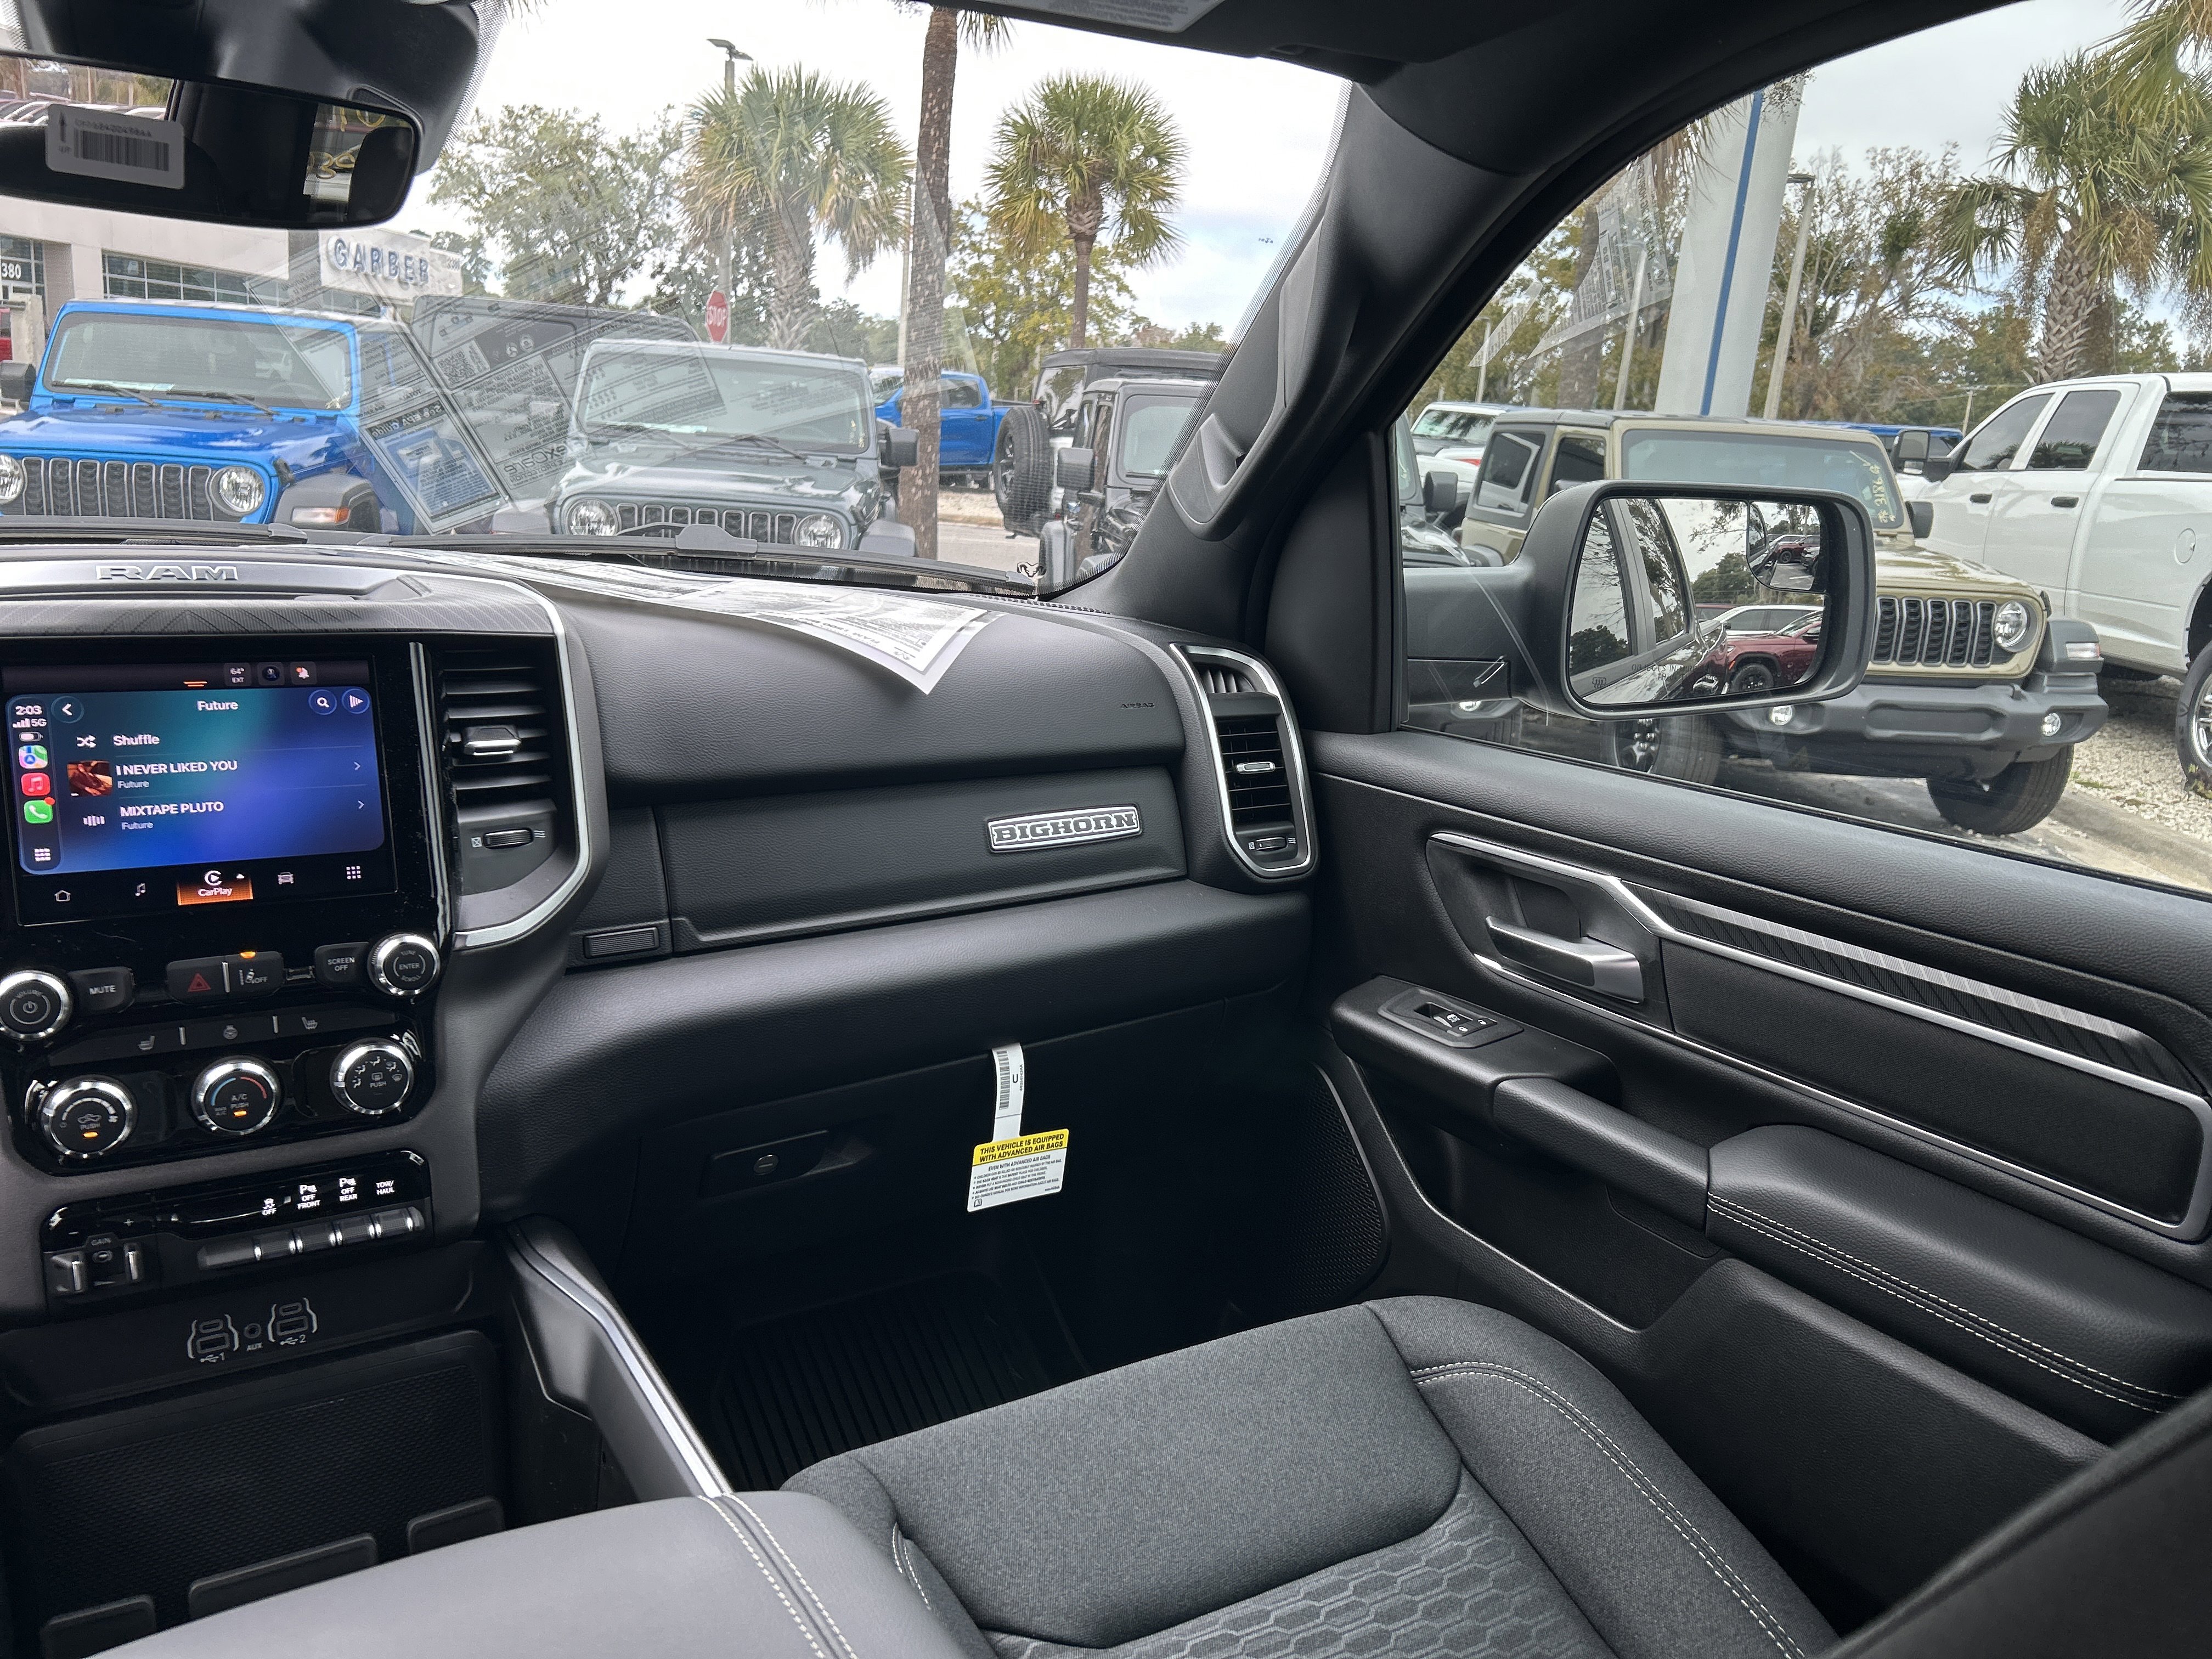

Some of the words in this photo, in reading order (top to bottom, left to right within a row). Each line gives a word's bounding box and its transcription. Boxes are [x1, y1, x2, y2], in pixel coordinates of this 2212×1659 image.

[332, 237, 430, 284] GARBER
[707, 306, 729, 328] STOP
[95, 565, 238, 581] RAM
[15, 705, 42, 715] 2:03
[196, 700, 239, 711] Future
[31, 718, 47, 727] 5G
[113, 734, 160, 746] Shuffle
[116, 765, 121, 776] I
[123, 763, 168, 775] NEVER
[170, 761, 207, 773] LIKED
[210, 760, 238, 771] YOU
[117, 780, 150, 789] Future
[120, 804, 178, 817] MIXTAPE
[180, 801, 224, 814] PLUTO
[121, 821, 154, 830] Future
[994, 812, 1136, 844] BIGHORN
[198, 887, 233, 896] CarPlay
[328, 957, 355, 966] SCREEN
[89, 985, 116, 995] MUTE
[1012, 1073, 1019, 1084] U
[980, 1146, 995, 1155] THIS
[997, 1141, 1024, 1152] VEHICLE
[1032, 1133, 1064, 1144] EQUIPPED
[979, 1153, 996, 1163] WITH
[997, 1147, 1033, 1159] ADVANCED
[1011, 1158, 1032, 1166] ADVANCED
[376, 1180, 394, 1189] TOW/
[339, 1194, 358, 1203] REAR
[297, 1200, 321, 1210] FRONT
[299, 1334, 306, 1343] 2
